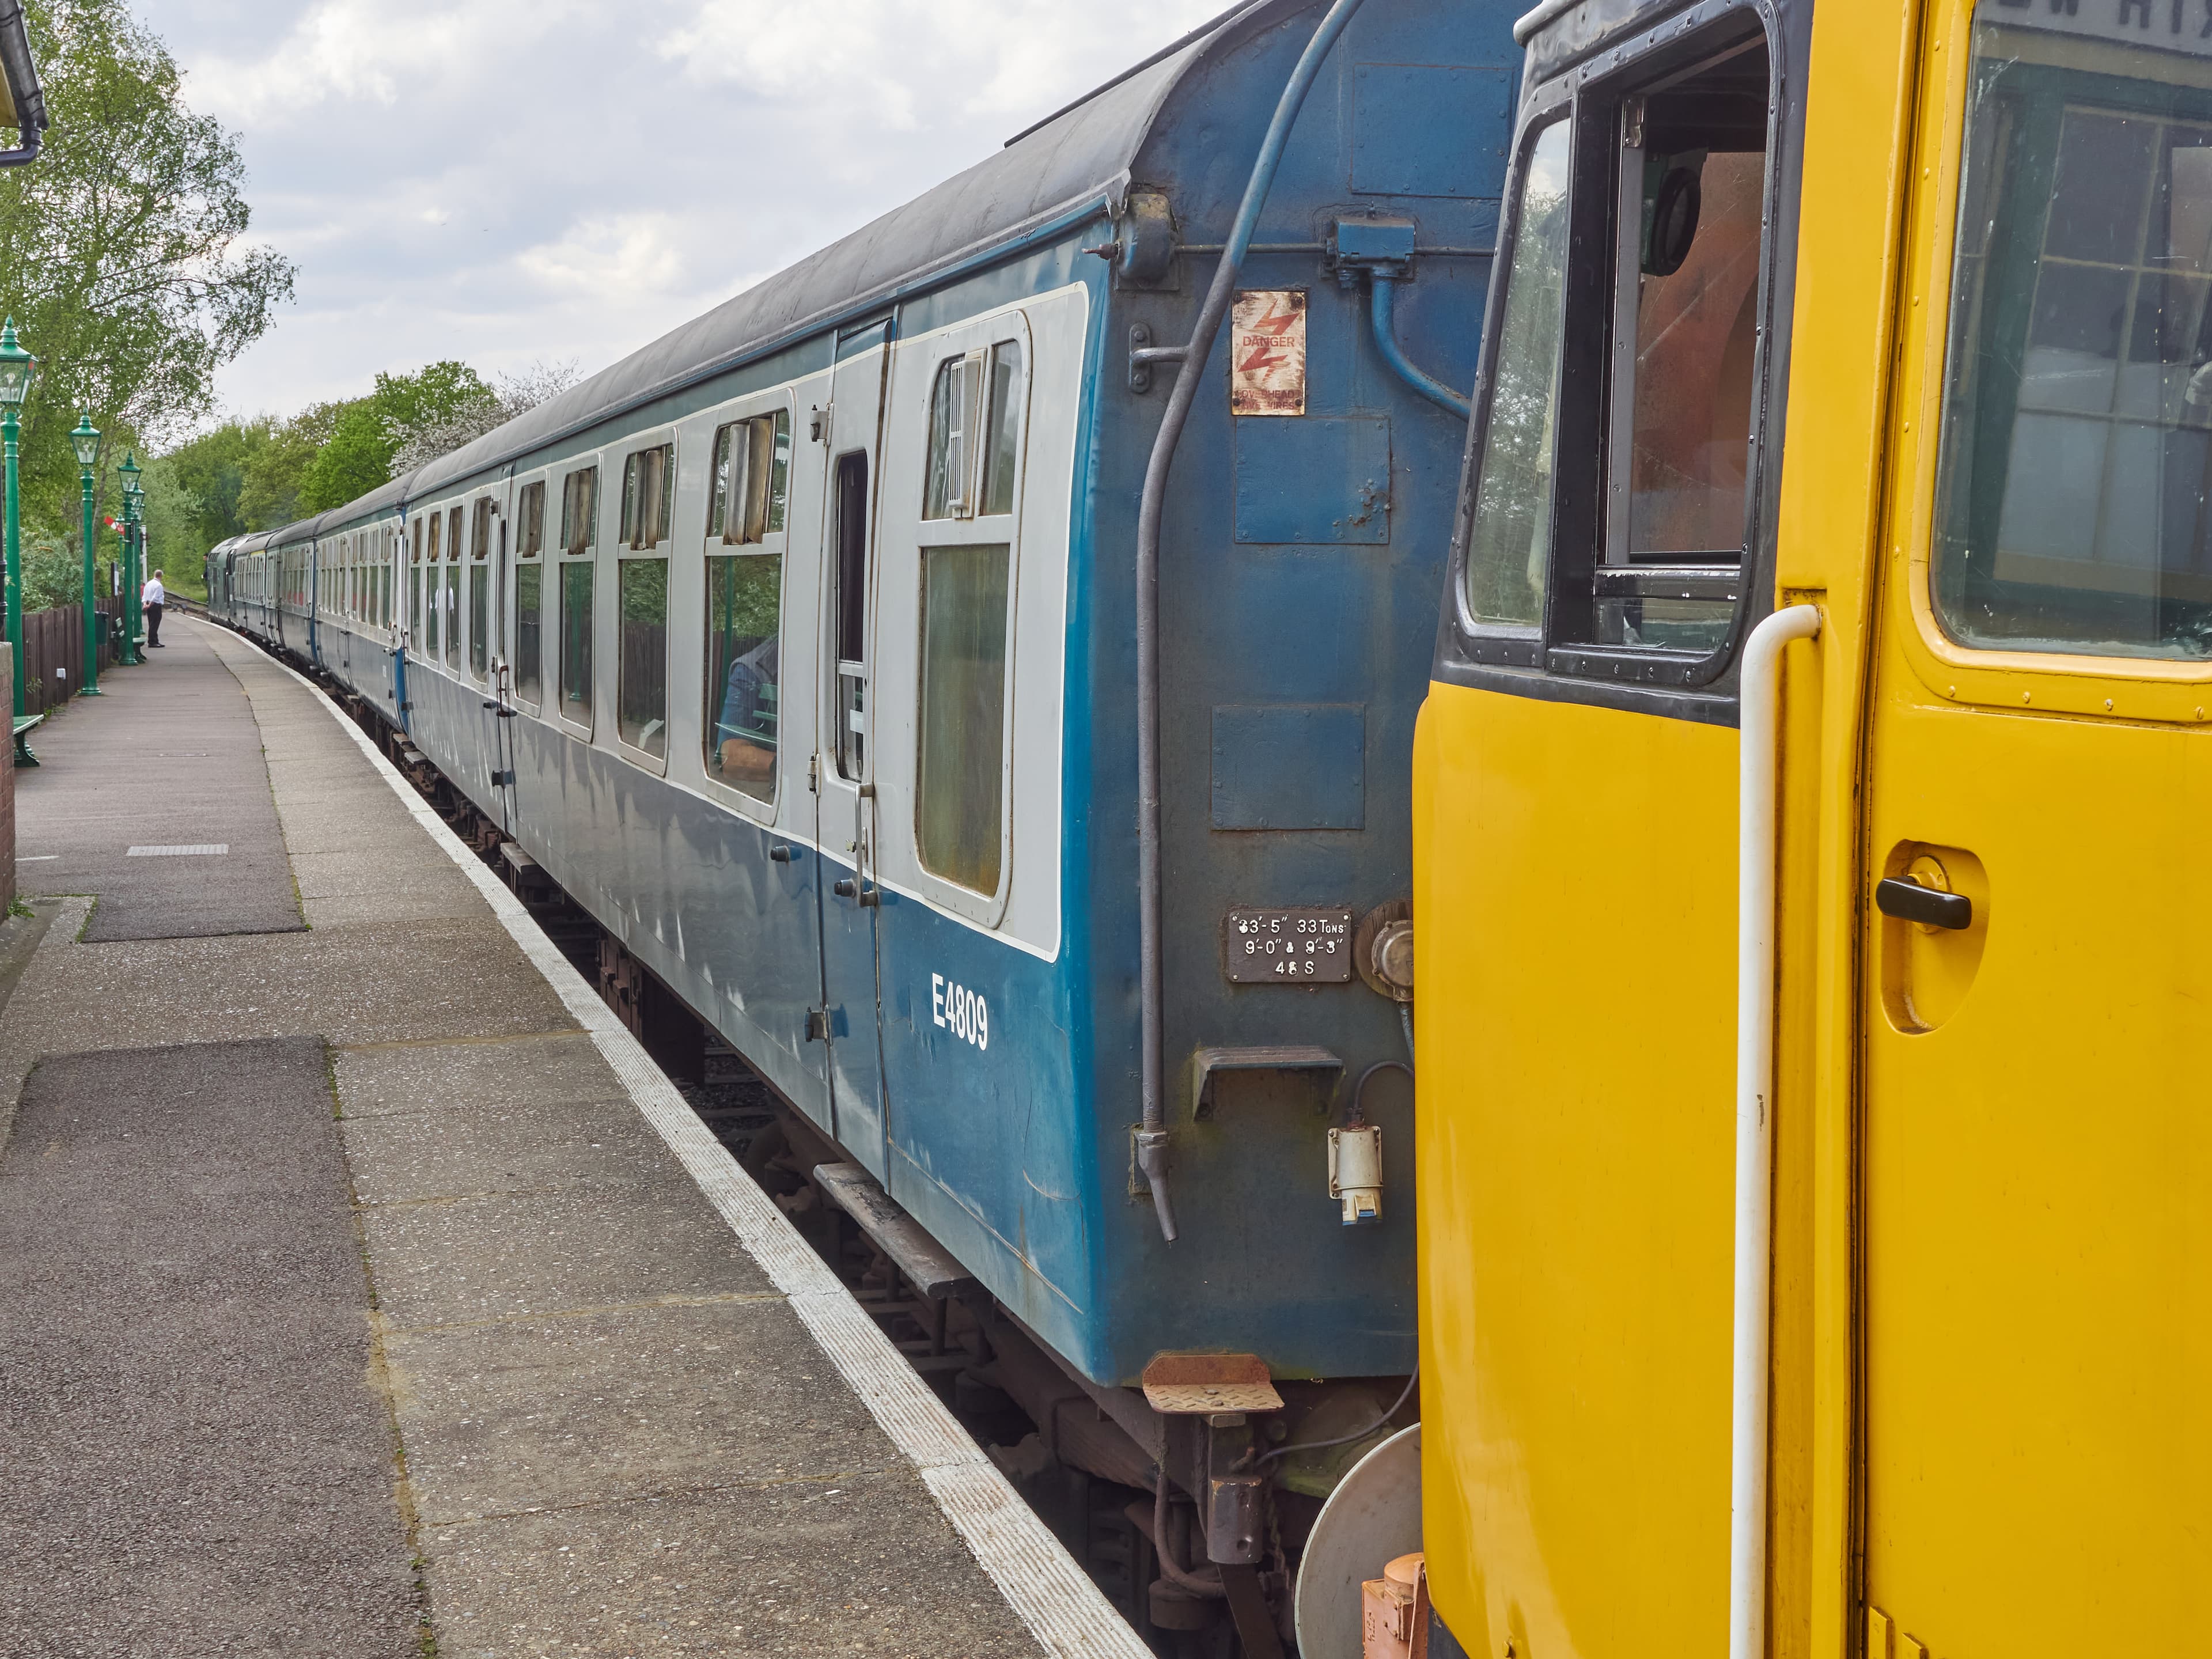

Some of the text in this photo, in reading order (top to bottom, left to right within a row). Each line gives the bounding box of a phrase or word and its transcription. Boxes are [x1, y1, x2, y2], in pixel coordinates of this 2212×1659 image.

[1243, 335, 1295, 347] DANGER
[1240, 389, 1295, 399] OVRHEAD
[1286, 941, 1294, 953] &
[932, 972, 988, 1051] E4809
